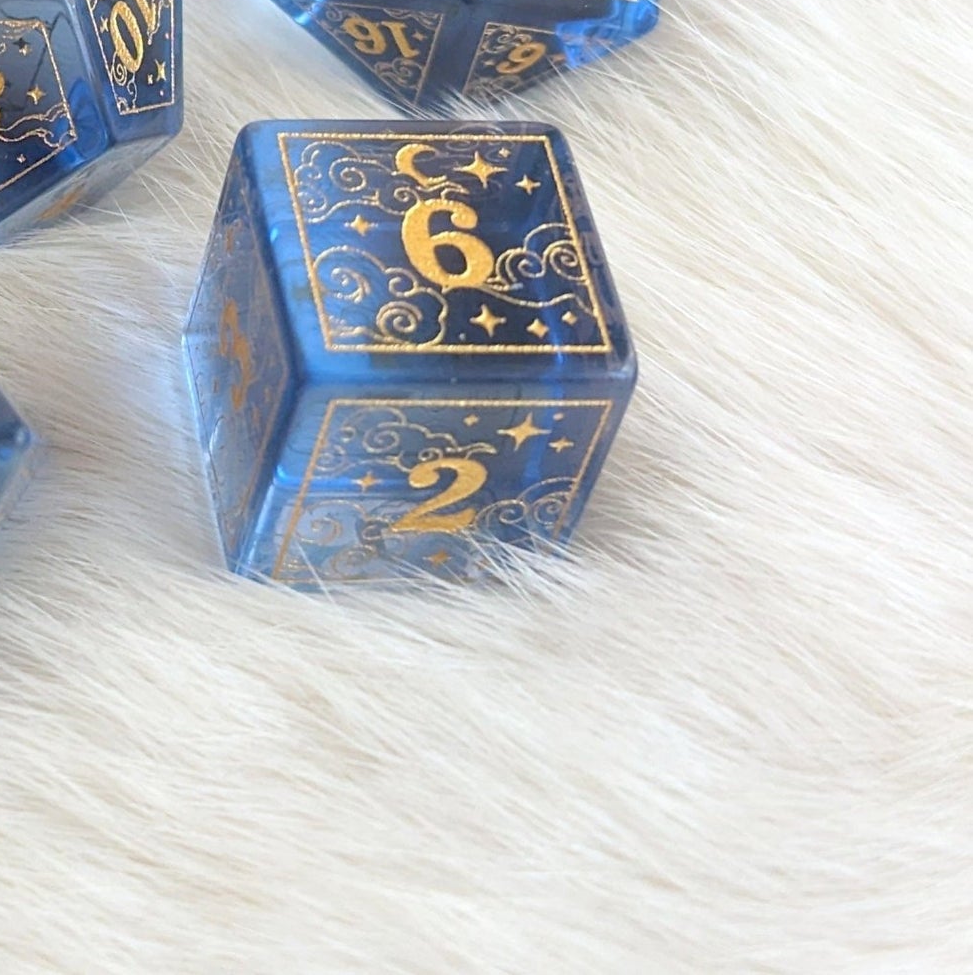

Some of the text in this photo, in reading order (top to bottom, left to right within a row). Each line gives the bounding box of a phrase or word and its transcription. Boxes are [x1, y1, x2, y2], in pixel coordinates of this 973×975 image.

[340, 17, 420, 59] 16
[401, 197, 496, 291] 6
[388, 457, 489, 534] 2
